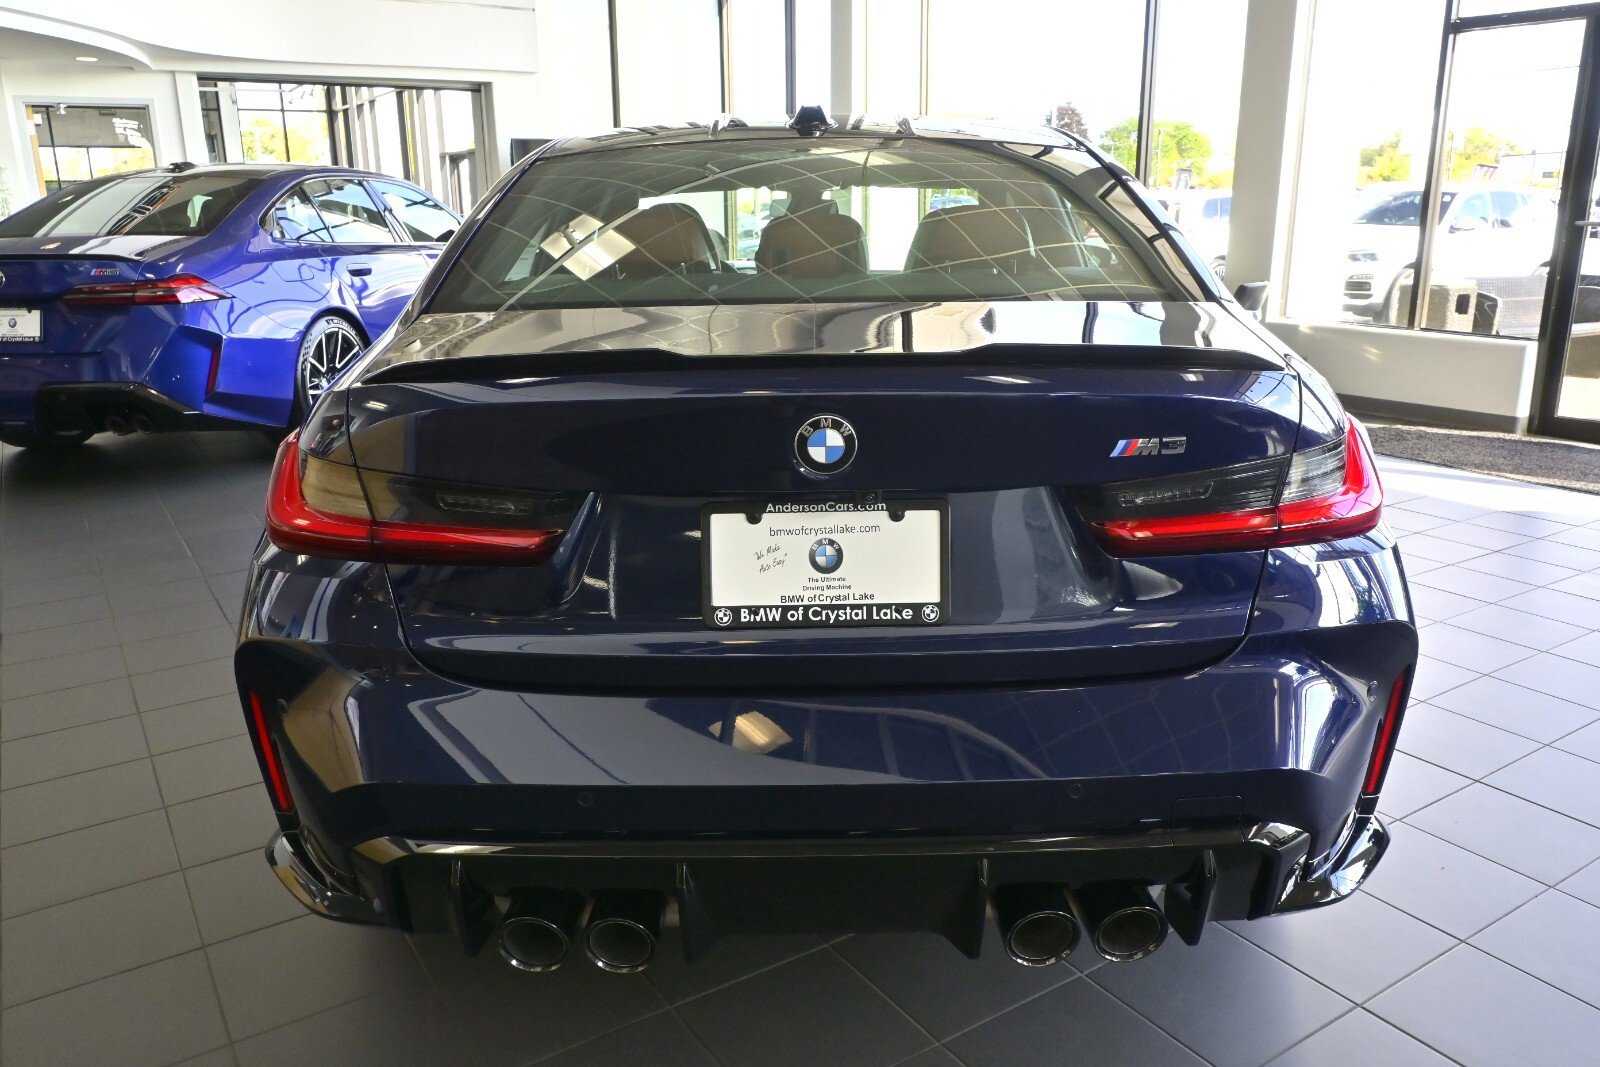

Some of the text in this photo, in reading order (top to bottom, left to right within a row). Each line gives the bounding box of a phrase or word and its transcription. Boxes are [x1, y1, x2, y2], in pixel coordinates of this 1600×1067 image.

[800, 417, 852, 438] BMW
[1130, 436, 1187, 456] M3
[765, 501, 887, 513] AndersonCars.com
[769, 524, 881, 537] bmwofcrystallake.com
[811, 539, 840, 551] BMW
[780, 592, 875, 604] BMW of Crystal Lake
[740, 605, 914, 624] BMW of Crystal Lake
